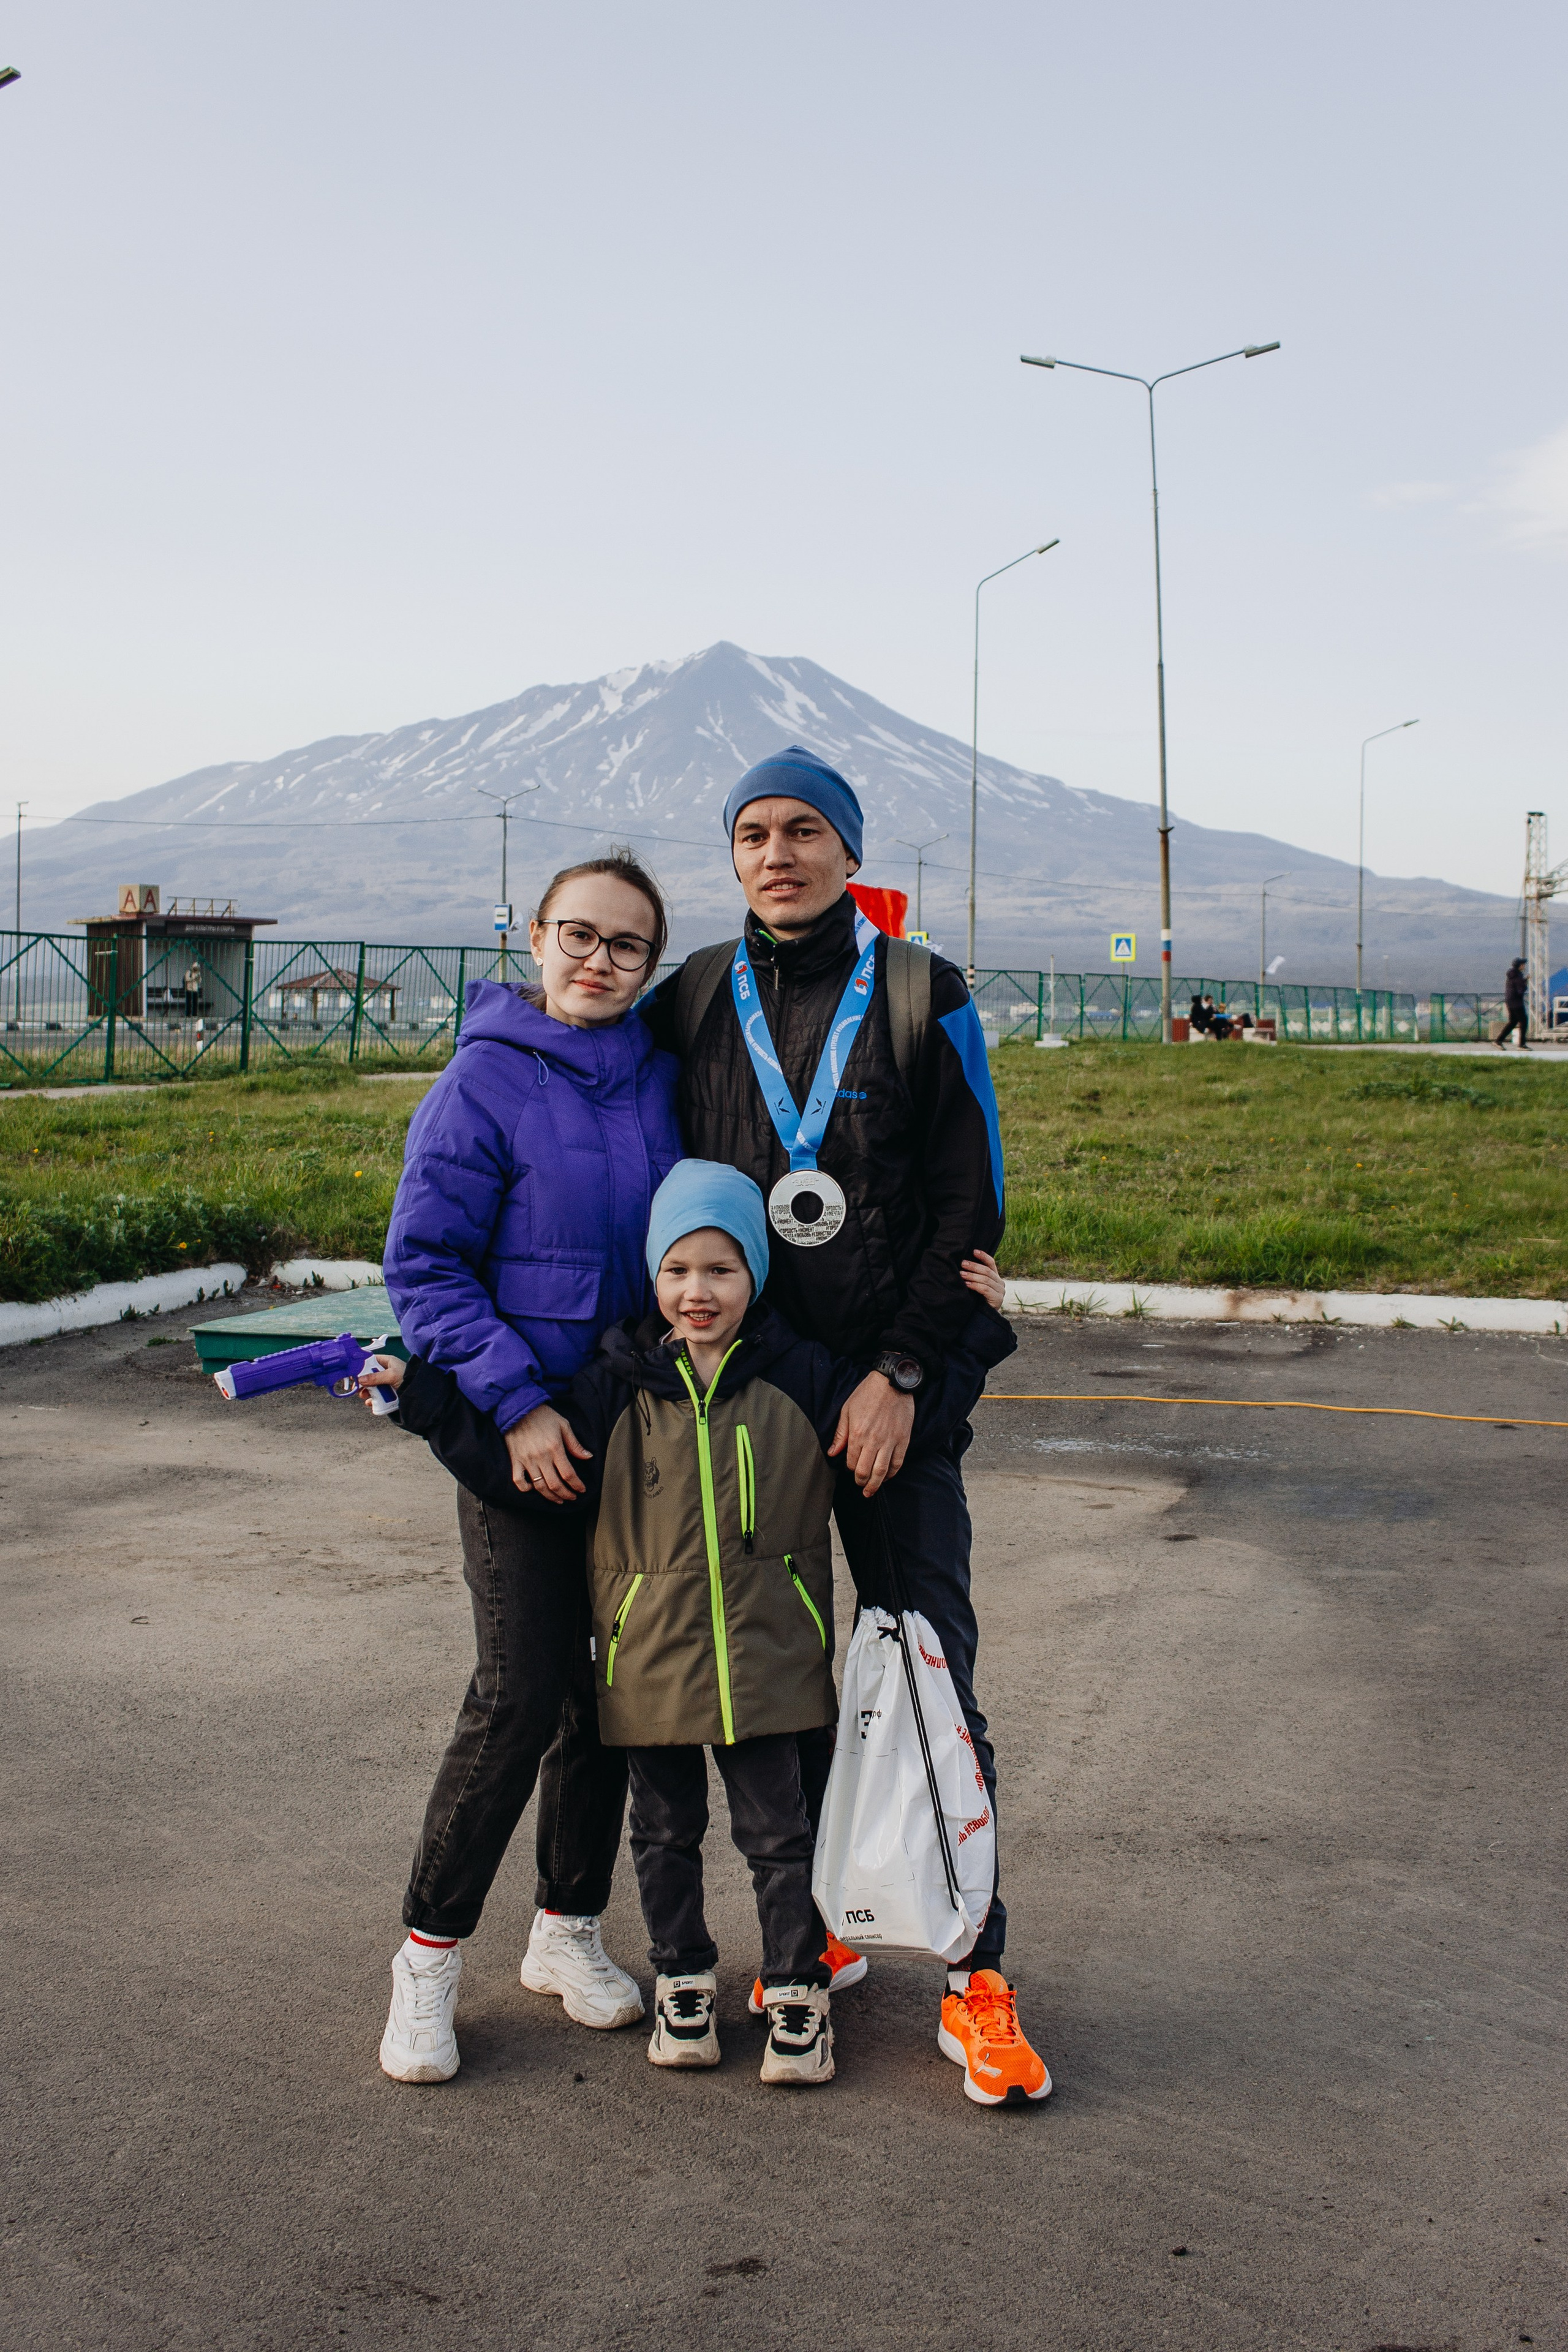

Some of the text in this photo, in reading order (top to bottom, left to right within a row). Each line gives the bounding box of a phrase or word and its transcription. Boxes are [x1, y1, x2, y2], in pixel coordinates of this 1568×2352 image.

[737, 974, 750, 1000] ПСБ
[837, 1088, 858, 1099] das
[845, 1909, 875, 1924] ПСБ
